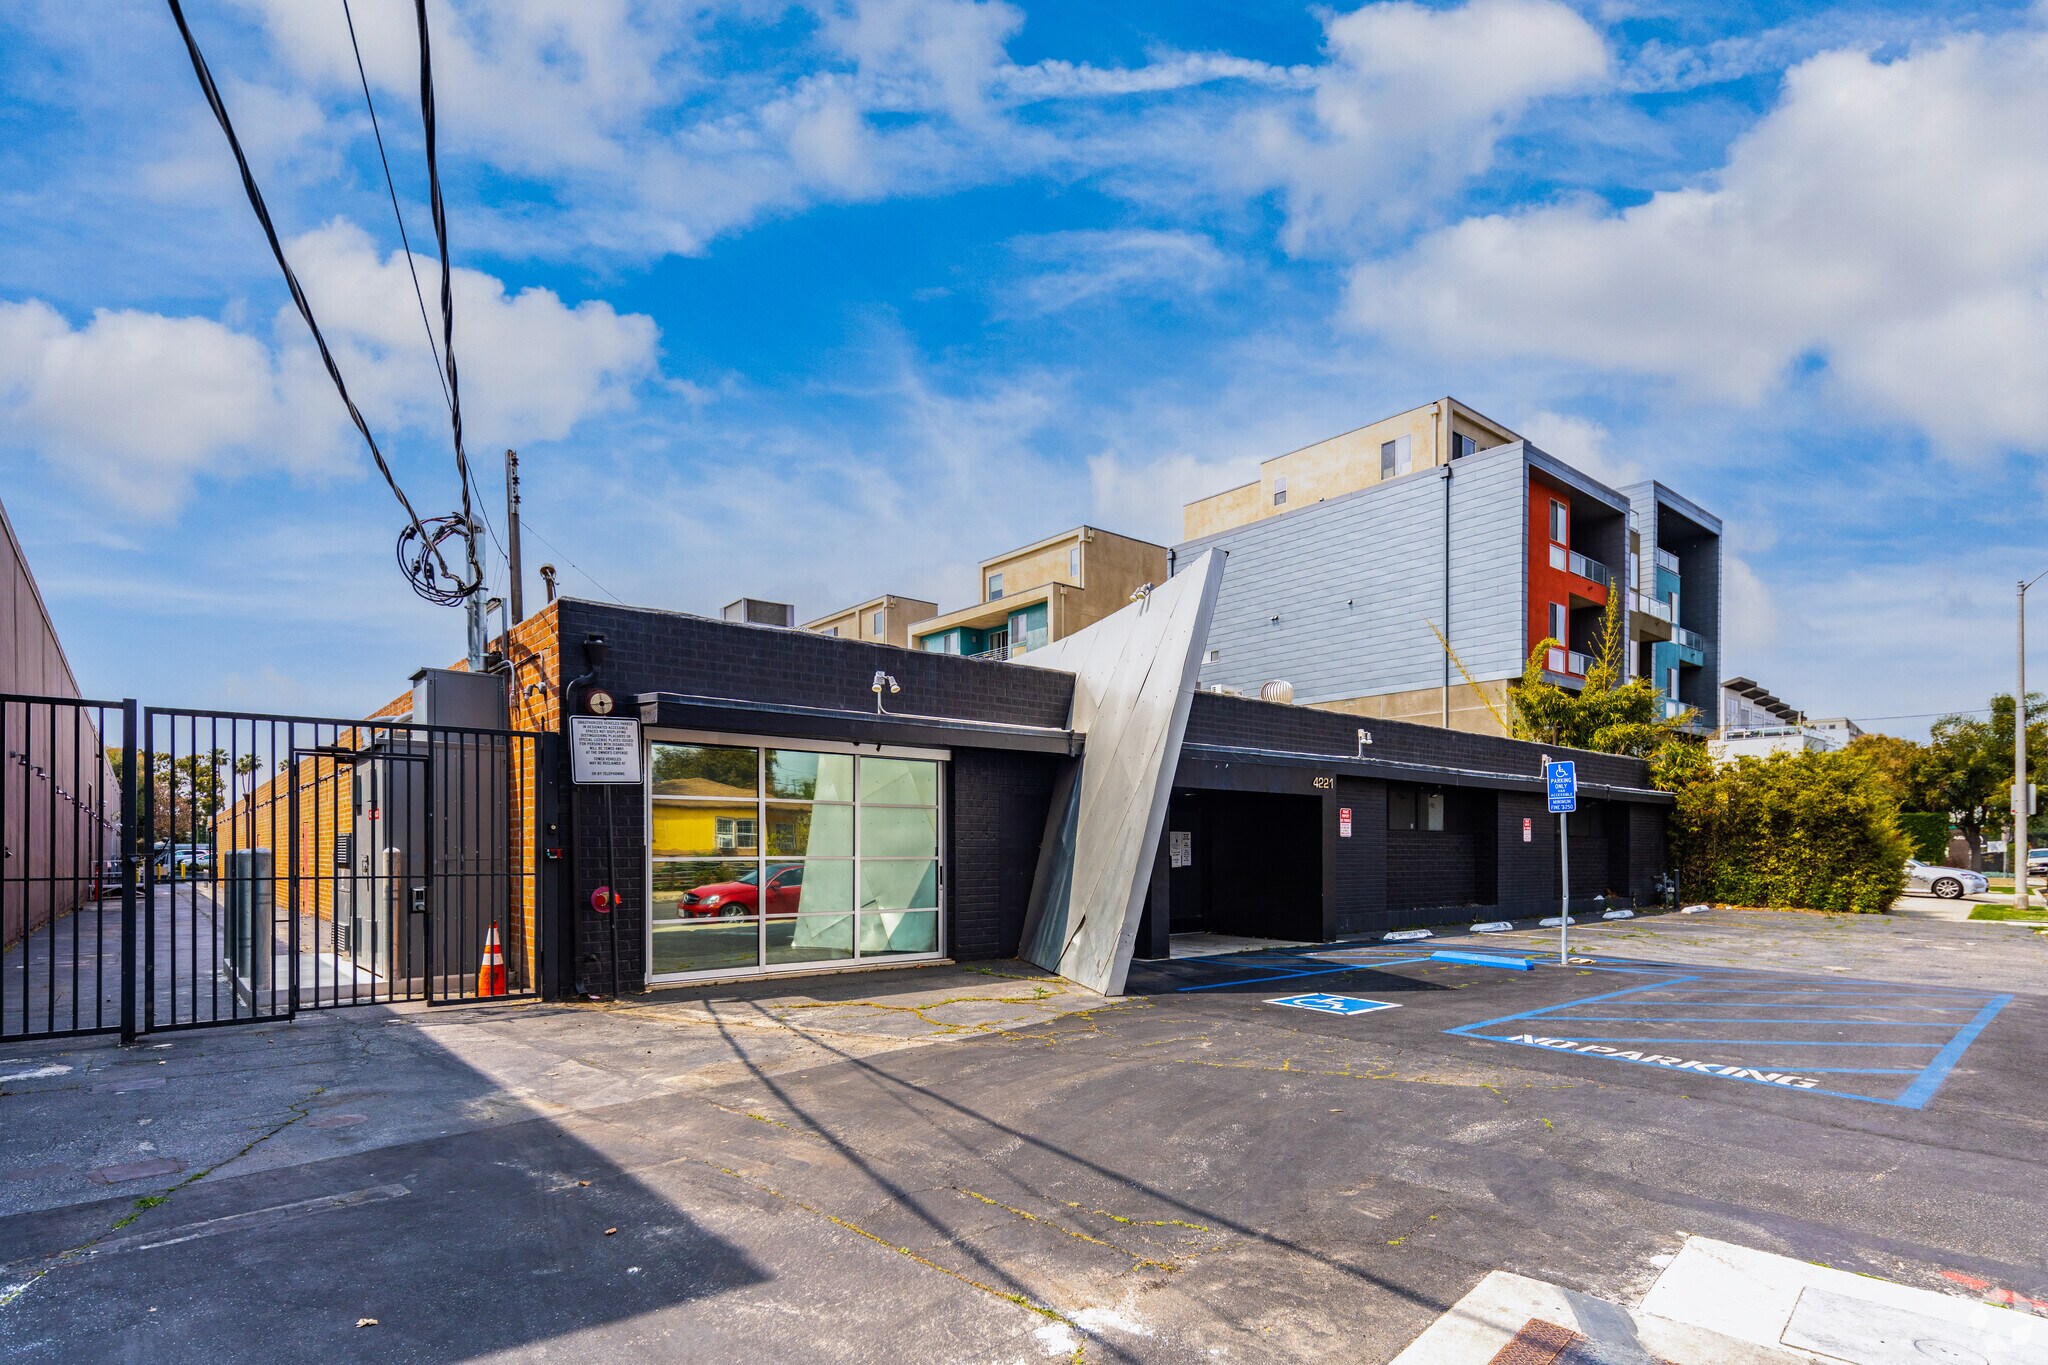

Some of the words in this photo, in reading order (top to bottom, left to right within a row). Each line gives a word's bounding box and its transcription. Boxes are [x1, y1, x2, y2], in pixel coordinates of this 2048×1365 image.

[1313, 777, 1334, 789] 4221
[1506, 1034, 1578, 1050] NO
[1576, 1045, 1820, 1088] PARKING
